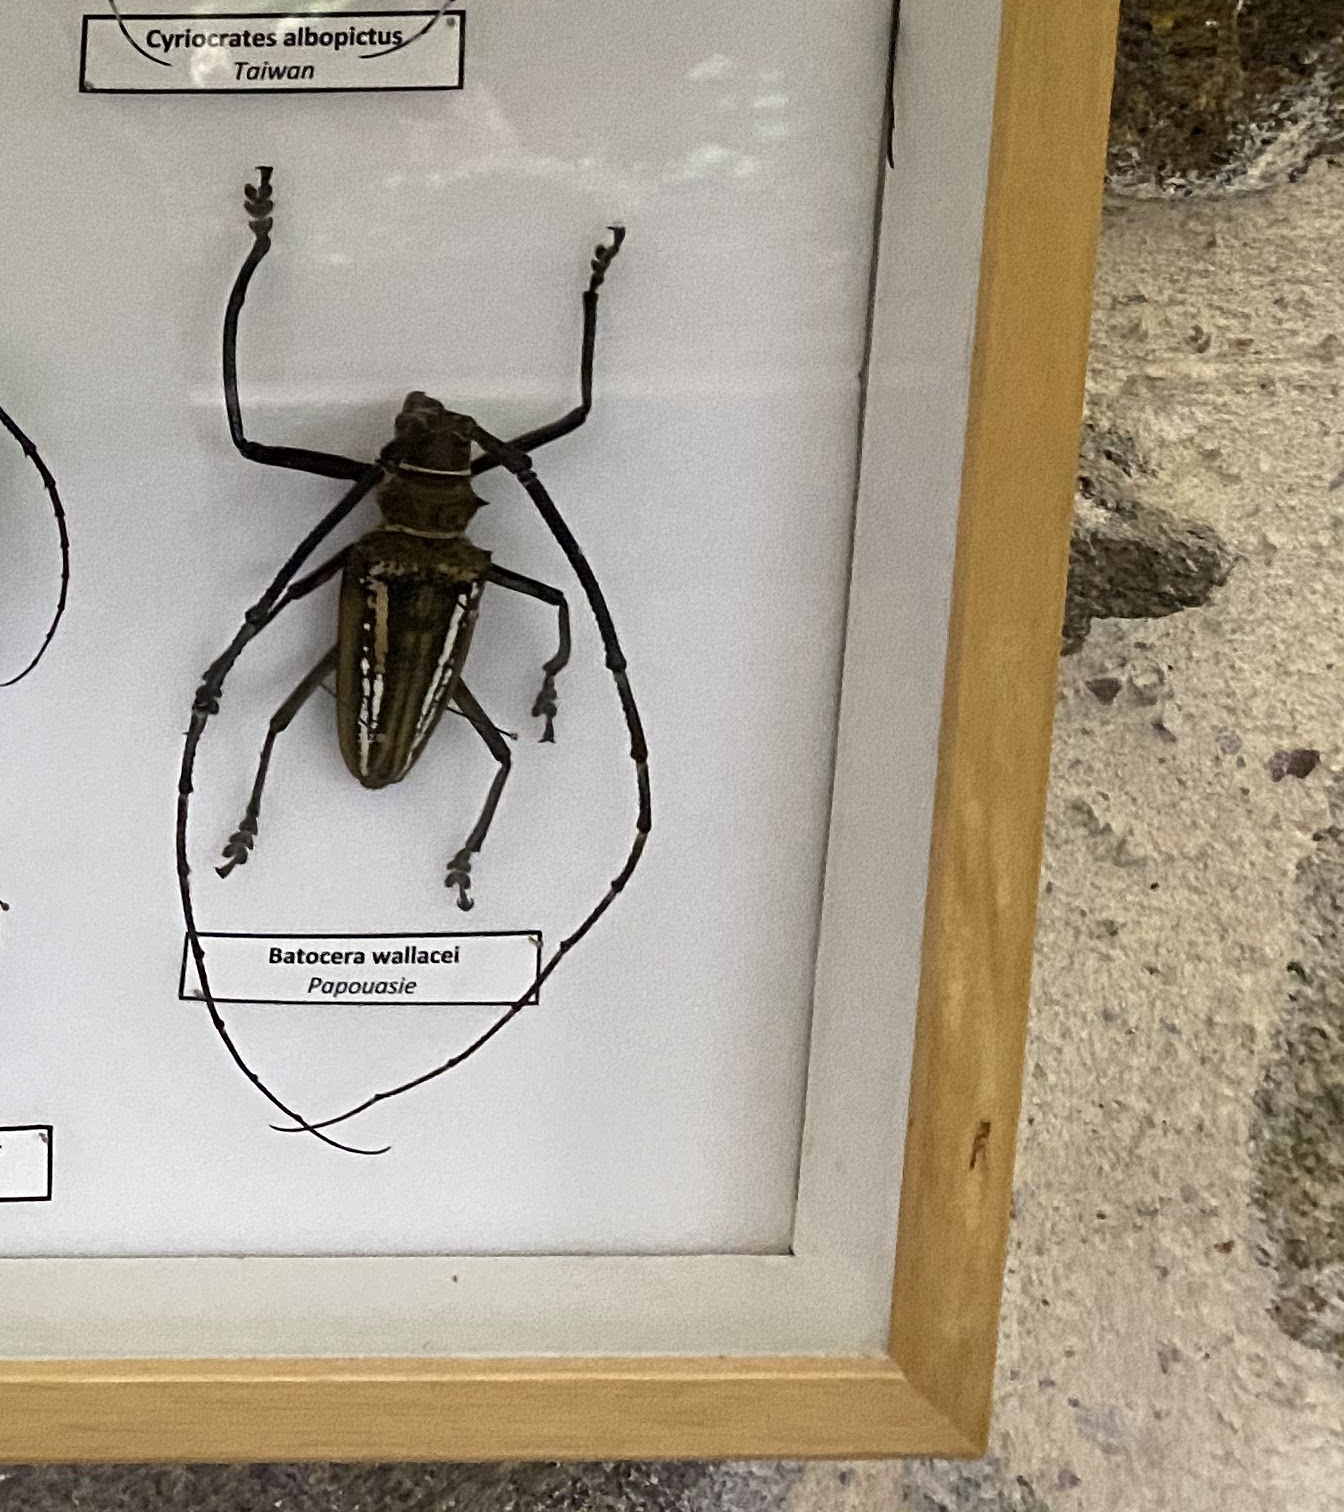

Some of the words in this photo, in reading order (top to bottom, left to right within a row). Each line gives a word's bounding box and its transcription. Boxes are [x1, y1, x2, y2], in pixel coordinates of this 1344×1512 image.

[146, 29, 277, 53] Cyriocrates
[283, 27, 403, 51] albopictus
[235, 61, 314, 80] Taiwan
[269, 947, 365, 964] Batocera
[373, 946, 459, 964] wallacei
[308, 977, 417, 998] Papouasie
